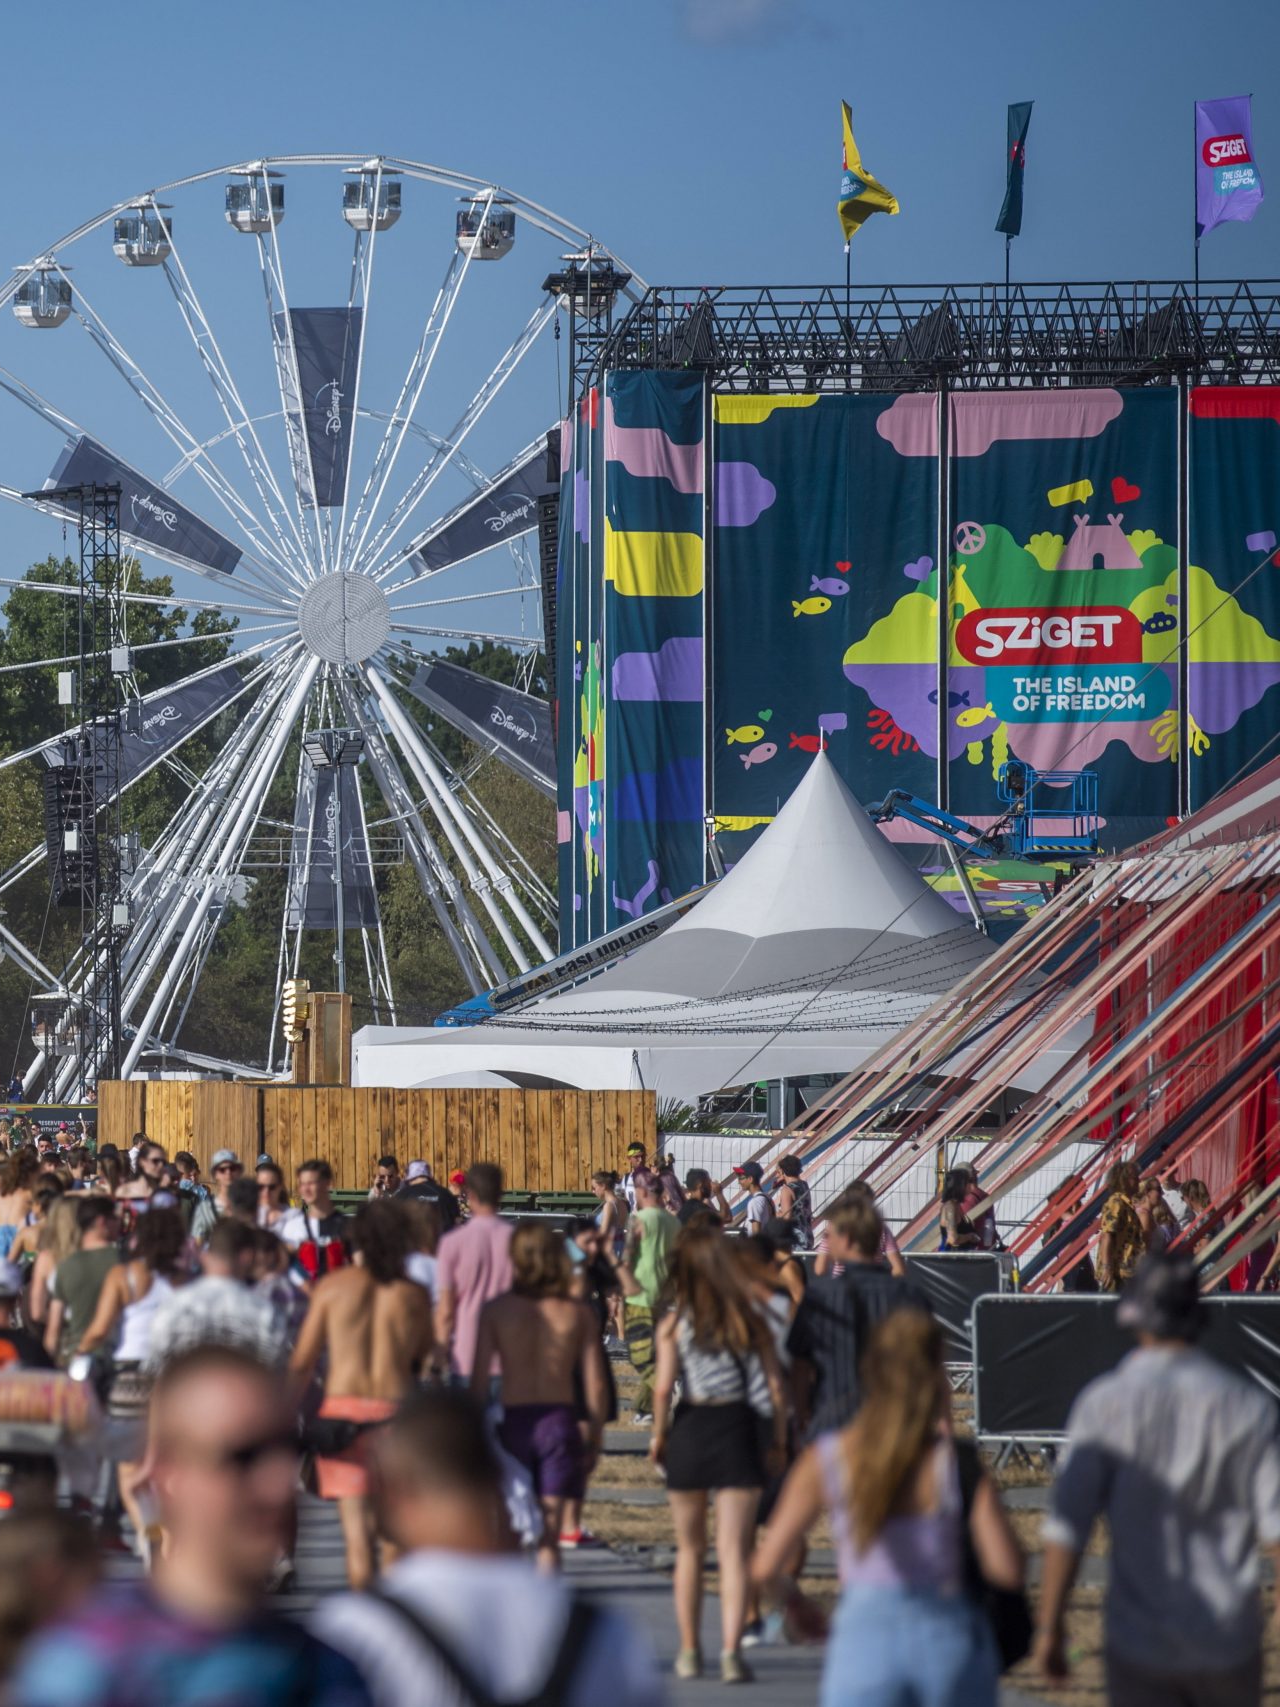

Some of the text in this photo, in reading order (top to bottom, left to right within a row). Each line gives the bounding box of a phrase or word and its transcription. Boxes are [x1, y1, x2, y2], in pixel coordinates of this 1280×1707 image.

[1222, 171, 1233, 180] THE
[1012, 675, 1136, 694] THE ISLAND
[1012, 693, 1146, 712] OF FREEDOM
